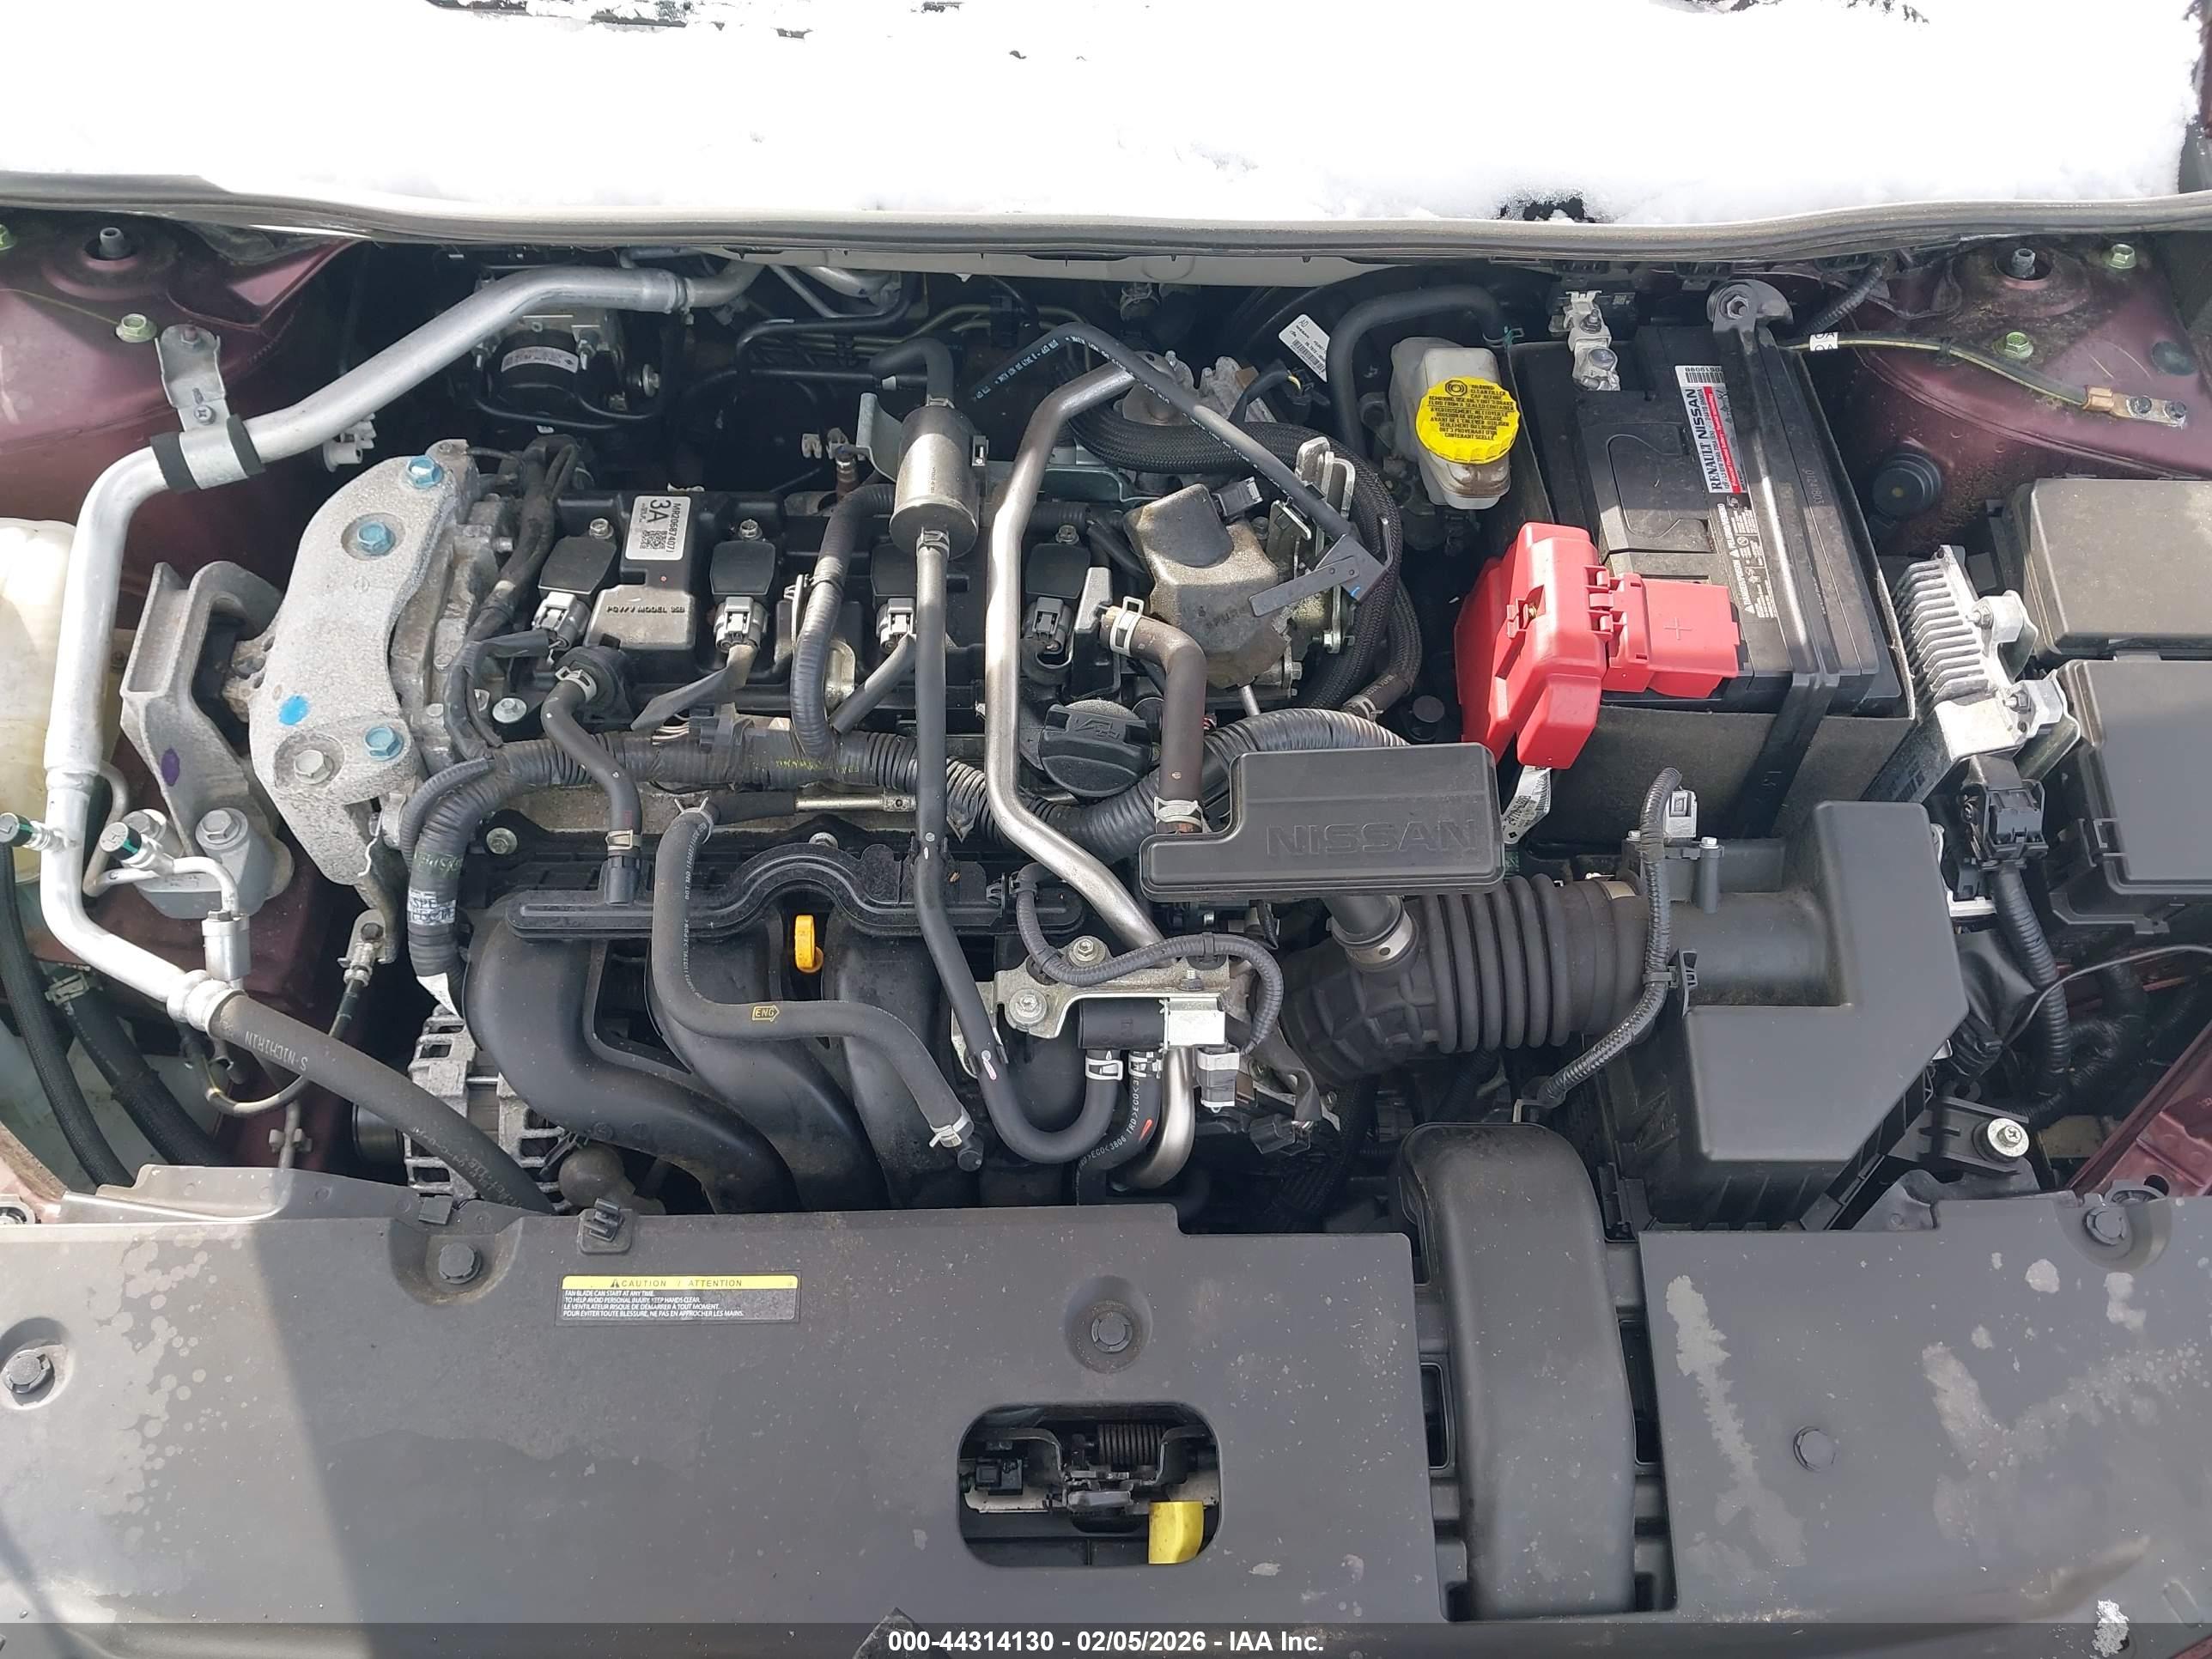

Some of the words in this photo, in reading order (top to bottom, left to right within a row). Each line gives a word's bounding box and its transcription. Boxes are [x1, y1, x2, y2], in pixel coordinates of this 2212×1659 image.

[1685, 389, 1708, 439] NISSAN
[1699, 442, 1723, 490] RENAULT
[647, 499, 672, 523] 3A
[1267, 818, 1477, 856] NISSAN
[755, 1007, 775, 1017] ENG
